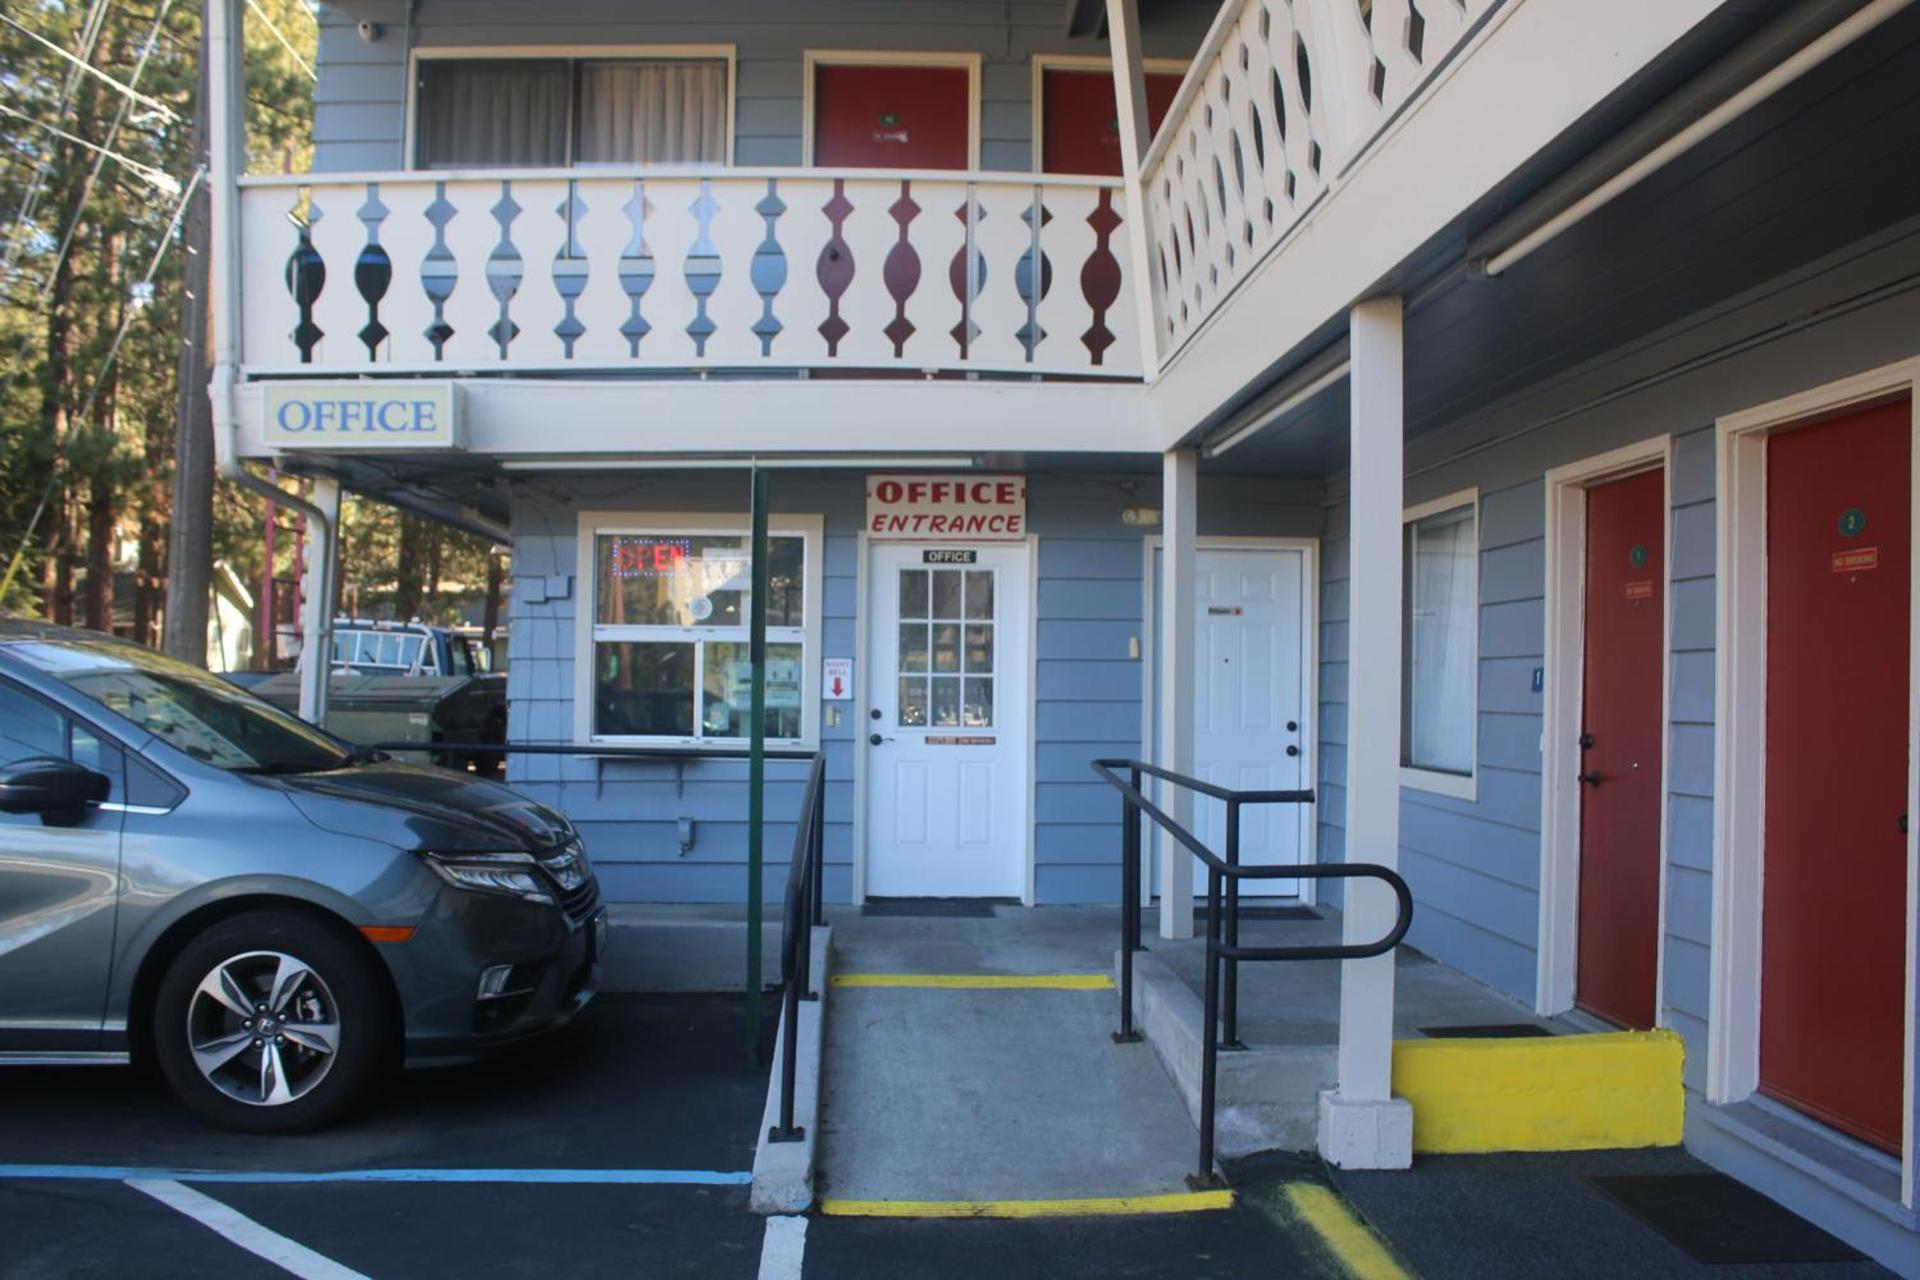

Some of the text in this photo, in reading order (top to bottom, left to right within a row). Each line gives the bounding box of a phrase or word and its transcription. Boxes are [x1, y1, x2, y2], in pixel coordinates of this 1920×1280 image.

[277, 400, 437, 432] OFFICE
[876, 480, 1016, 504] OFFICE
[871, 514, 1021, 533] ENTRANCE
[618, 546, 686, 572] OPEN
[928, 551, 971, 562] OFFICE
